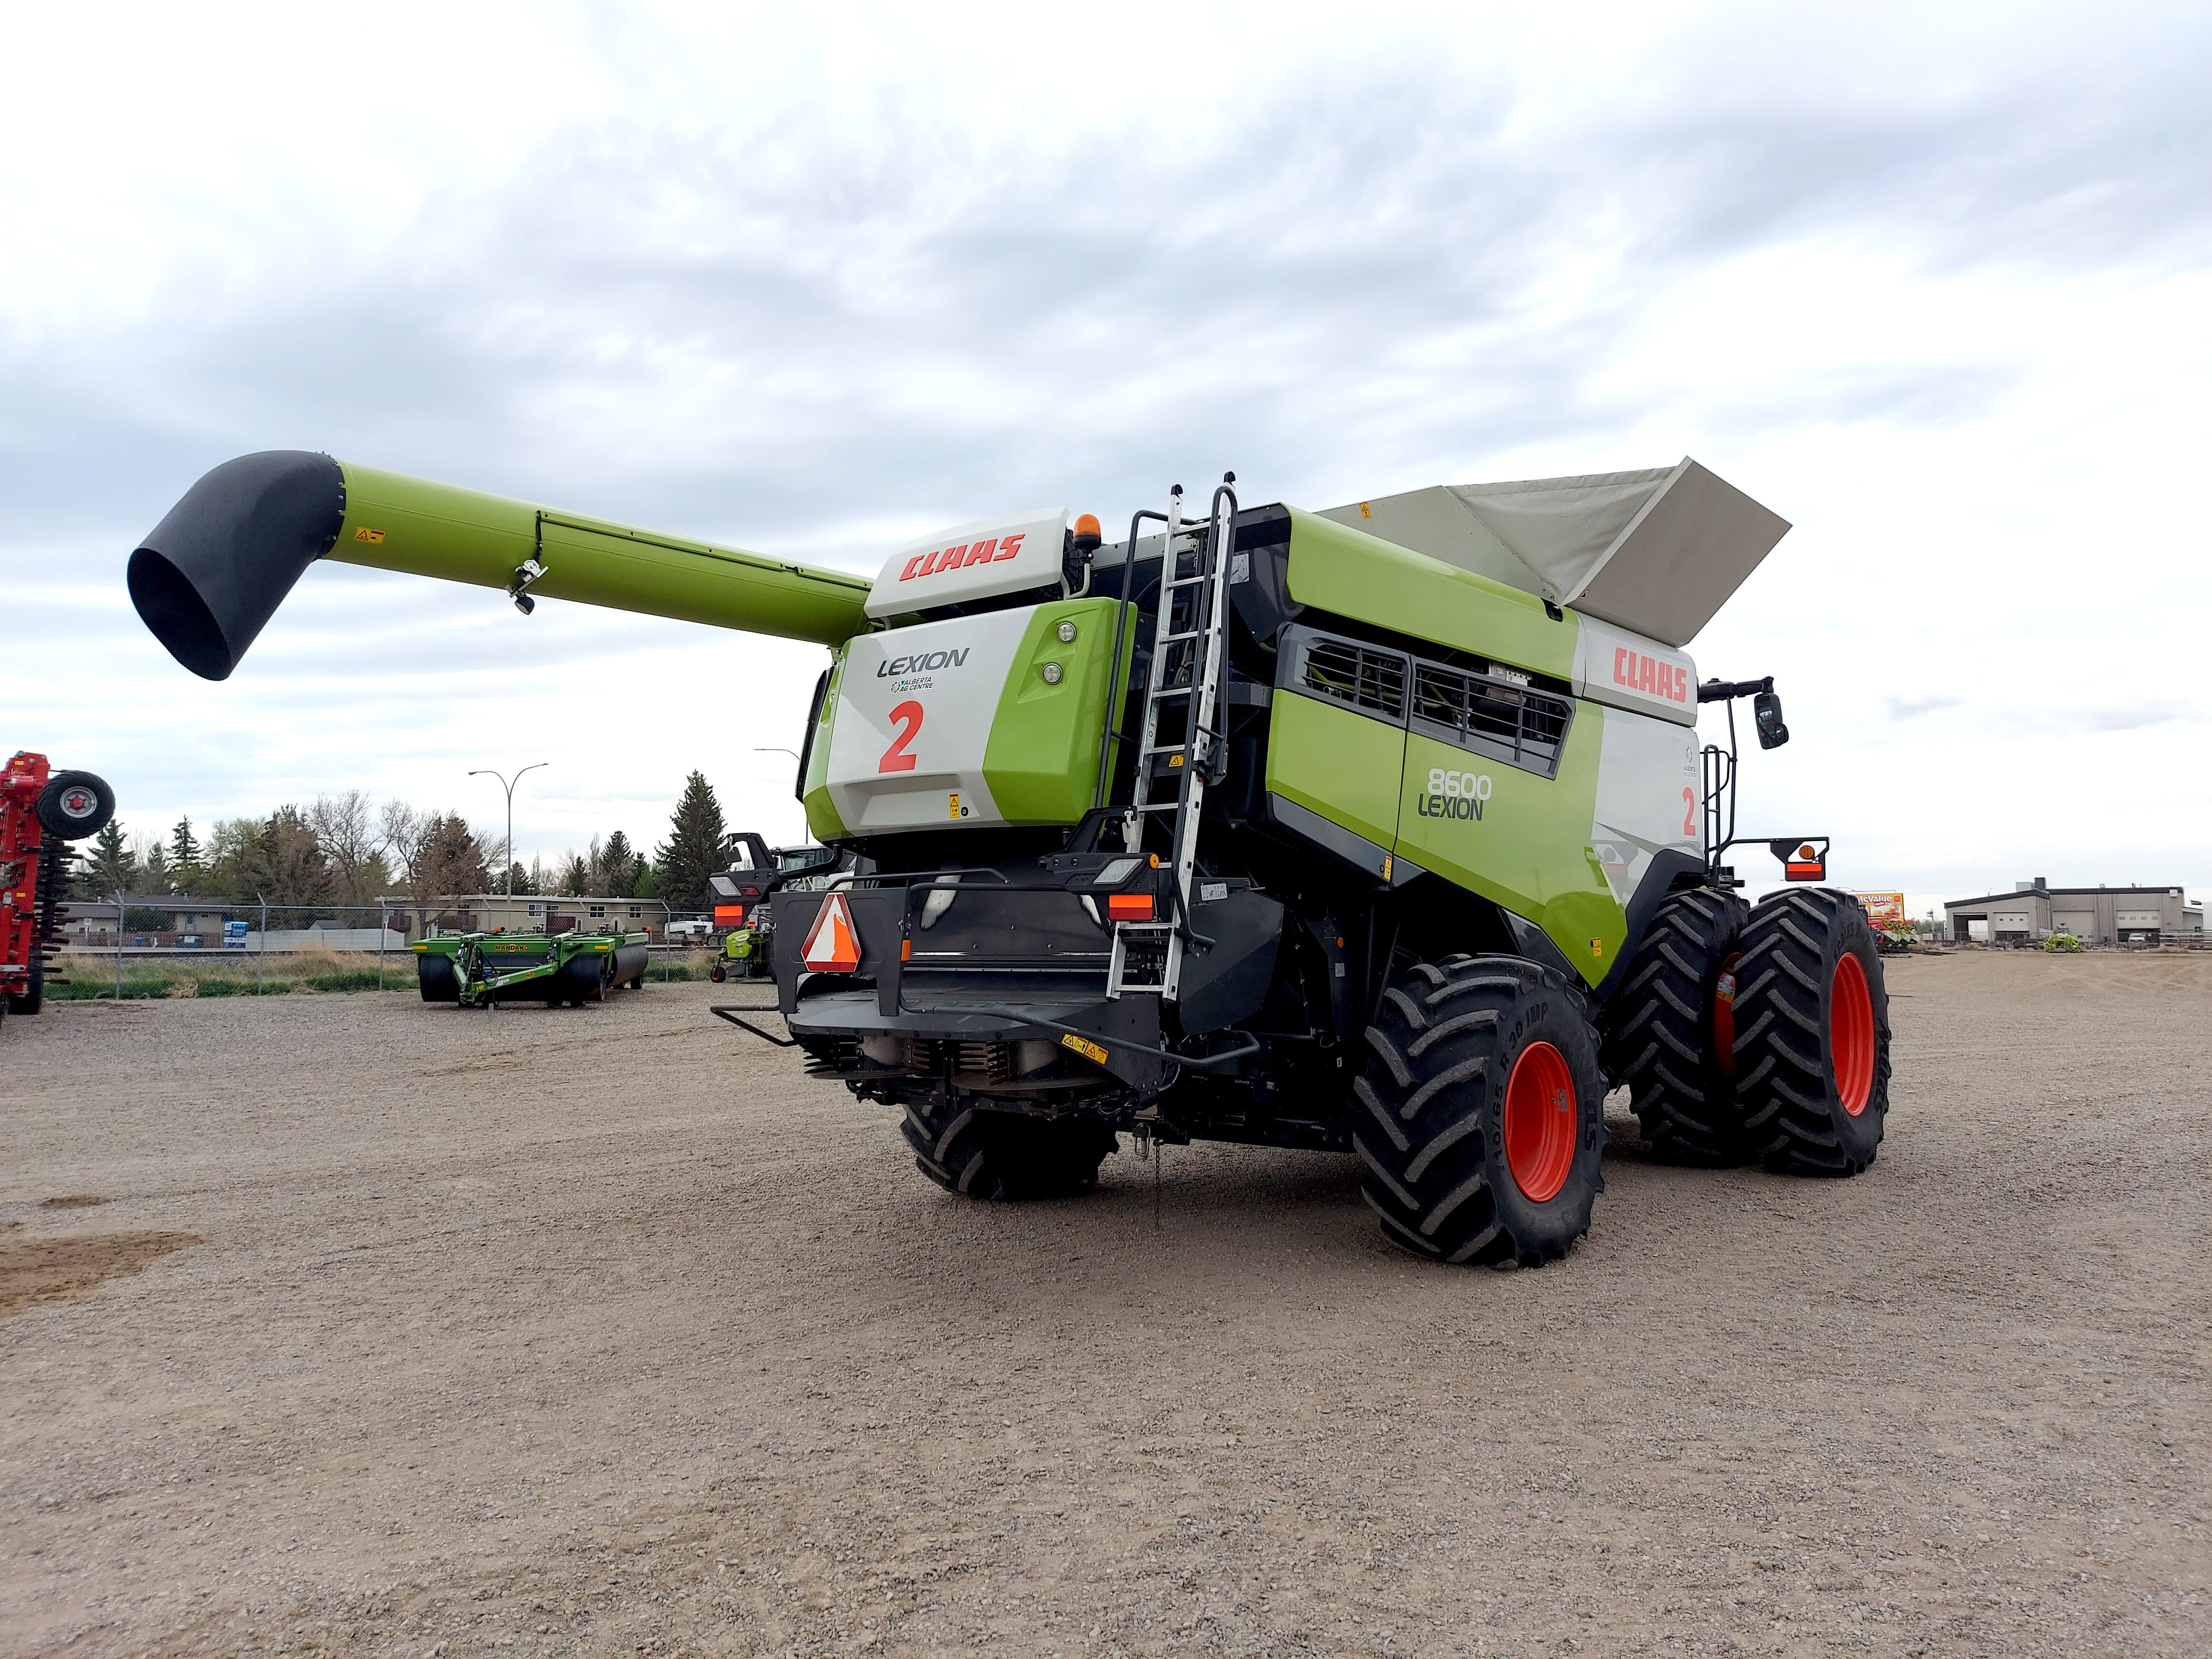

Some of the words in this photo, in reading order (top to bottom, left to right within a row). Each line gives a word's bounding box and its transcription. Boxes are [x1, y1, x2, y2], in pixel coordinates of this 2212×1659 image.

[899, 534, 1026, 581] CLAAS
[877, 647, 970, 678] LEXION
[1614, 647, 1687, 703] CLAAS
[903, 676, 932, 686] ALBERTA
[909, 683, 934, 691] CENTRE
[878, 700, 924, 774] 2
[1427, 768, 1492, 800] 8600
[1418, 793, 1483, 821] LEXION
[1682, 786, 1696, 836] 2
[1858, 895, 1892, 903] McValue
